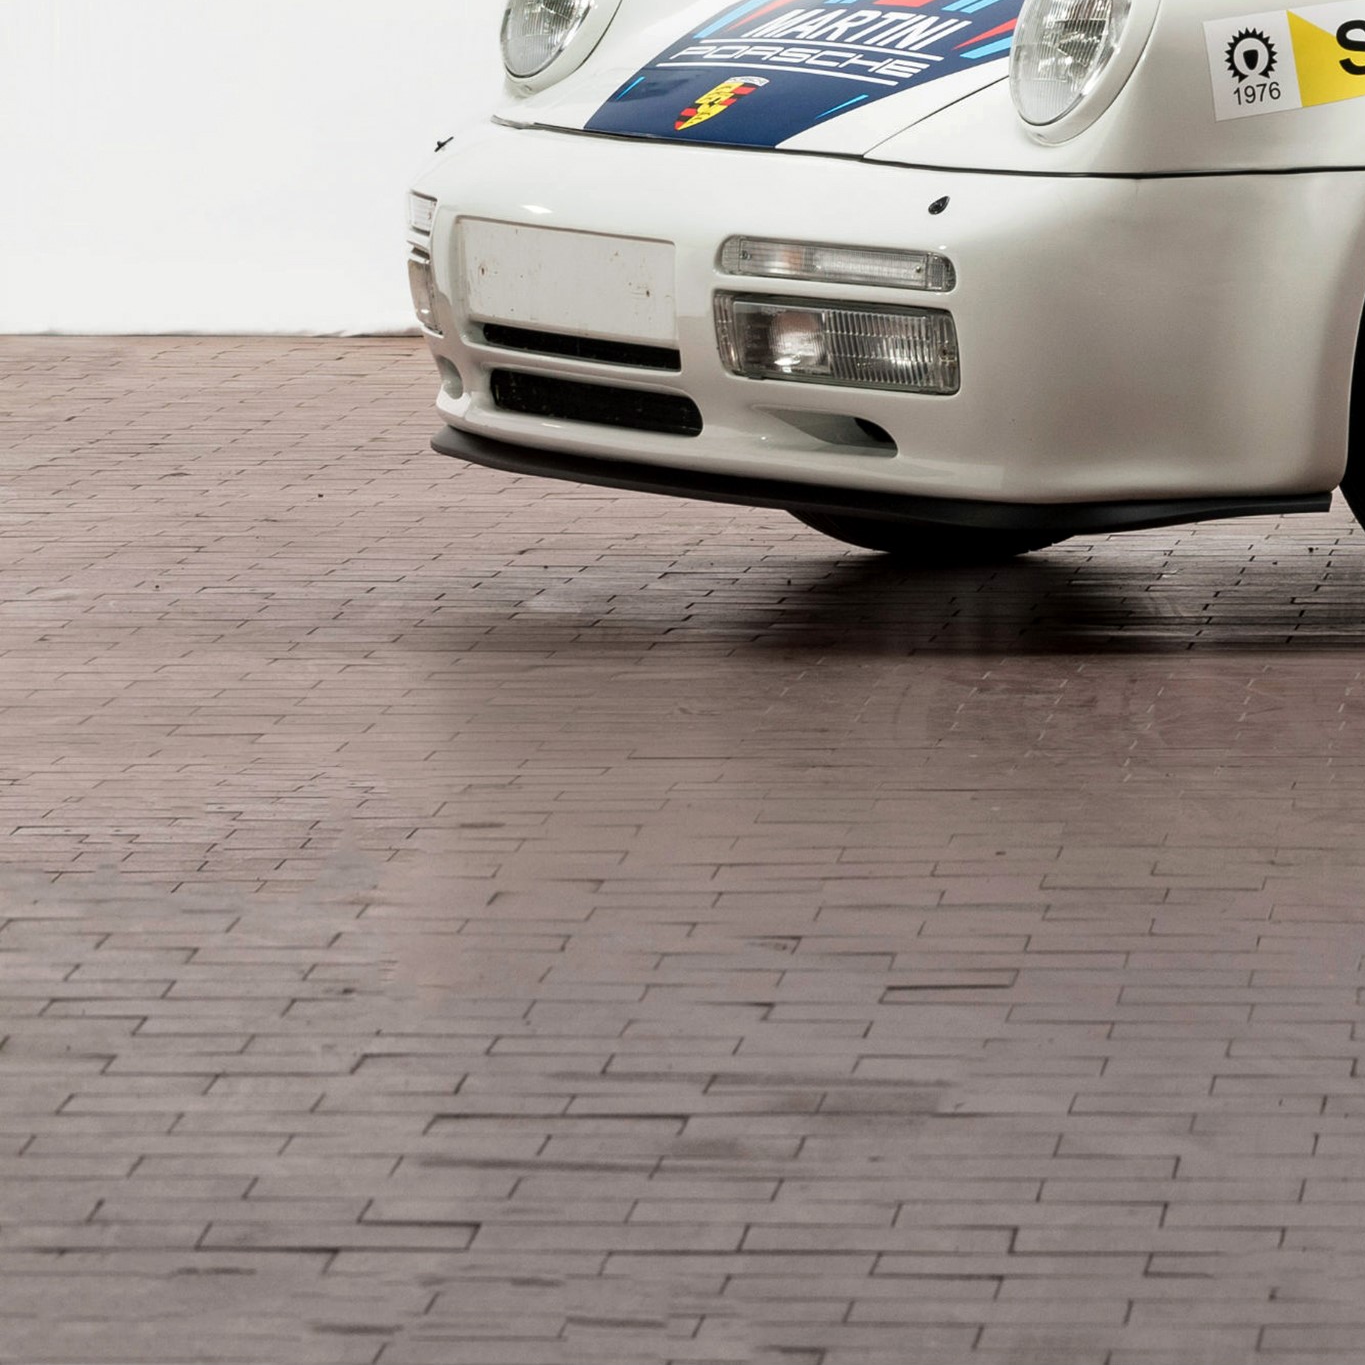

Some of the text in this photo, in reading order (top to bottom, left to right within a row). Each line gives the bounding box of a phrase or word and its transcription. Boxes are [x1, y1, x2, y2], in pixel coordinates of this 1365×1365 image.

[742, 9, 972, 50] MARTINI
[669, 45, 930, 78] PORSCHE
[1233, 82, 1281, 105] 1976
